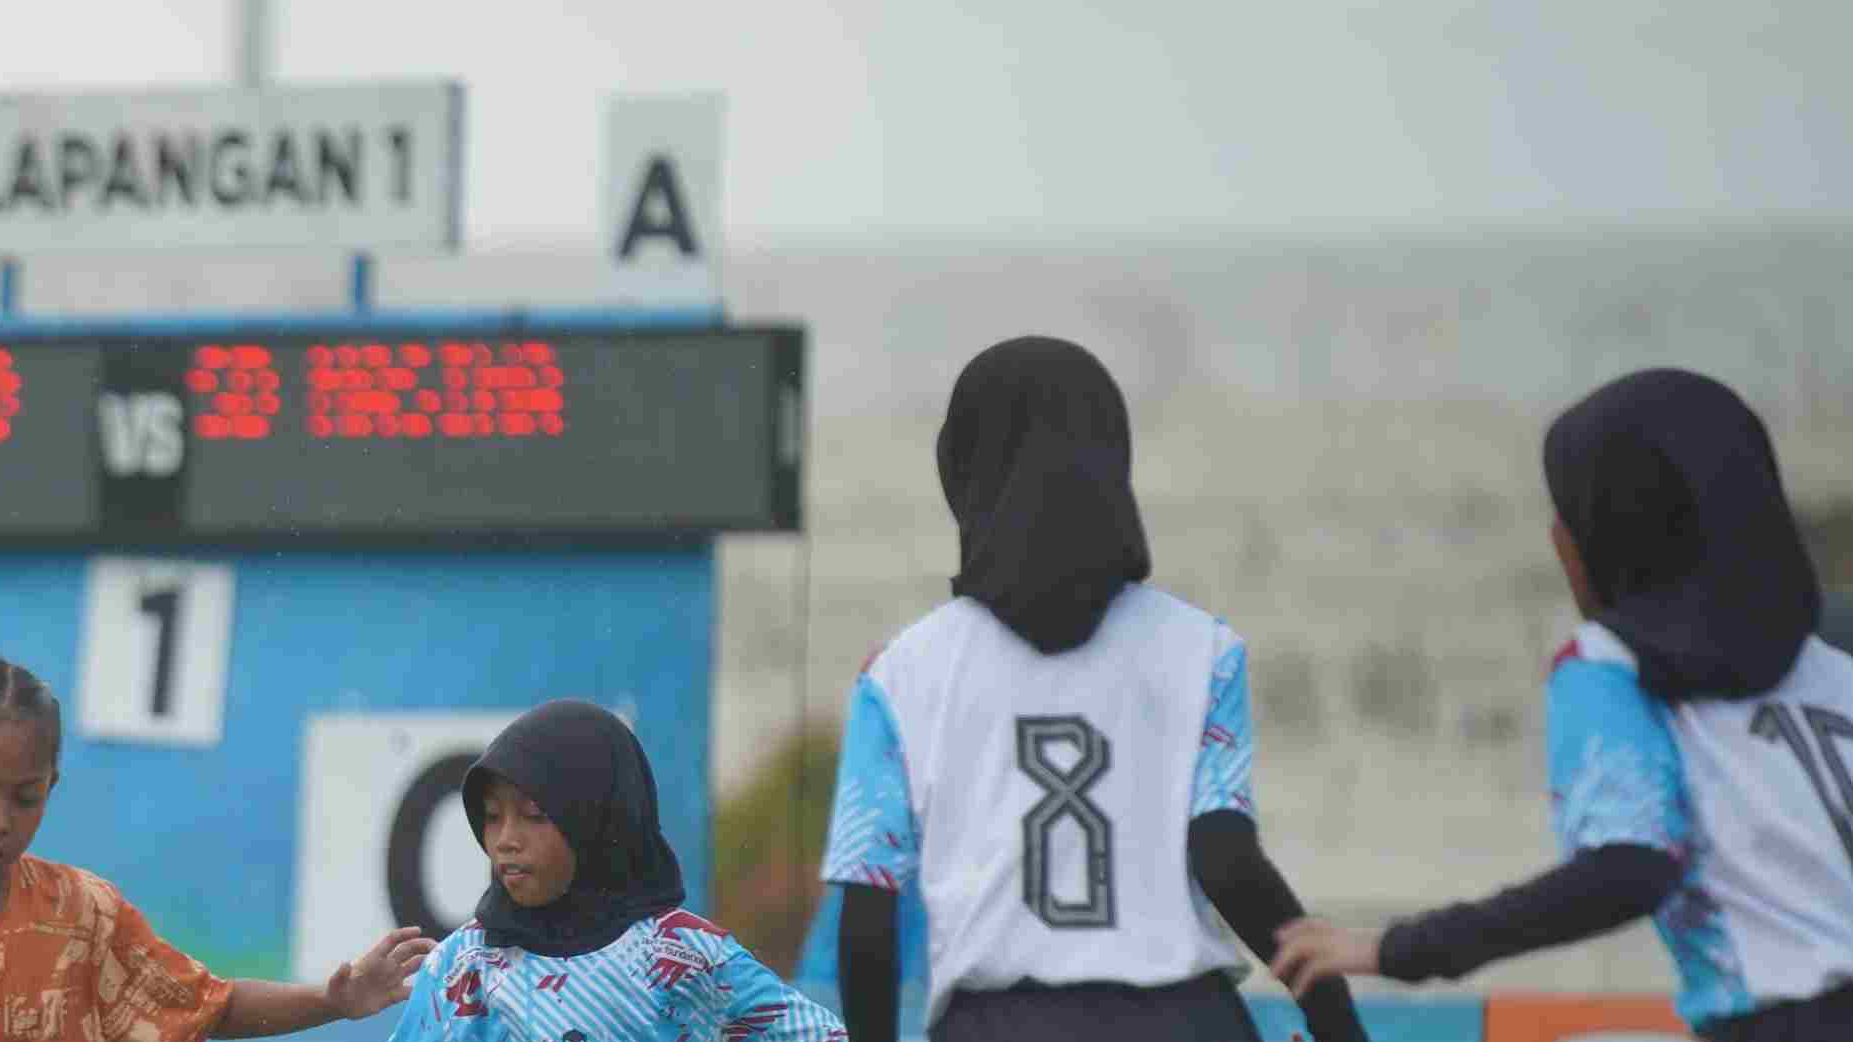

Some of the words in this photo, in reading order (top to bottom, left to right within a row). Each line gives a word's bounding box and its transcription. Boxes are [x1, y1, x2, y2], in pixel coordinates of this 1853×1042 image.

[387, 126, 414, 204] 1
[615, 151, 700, 259] A
[98, 391, 183, 477] VS
[138, 584, 187, 718] 1
[1014, 714, 1117, 929] 8
